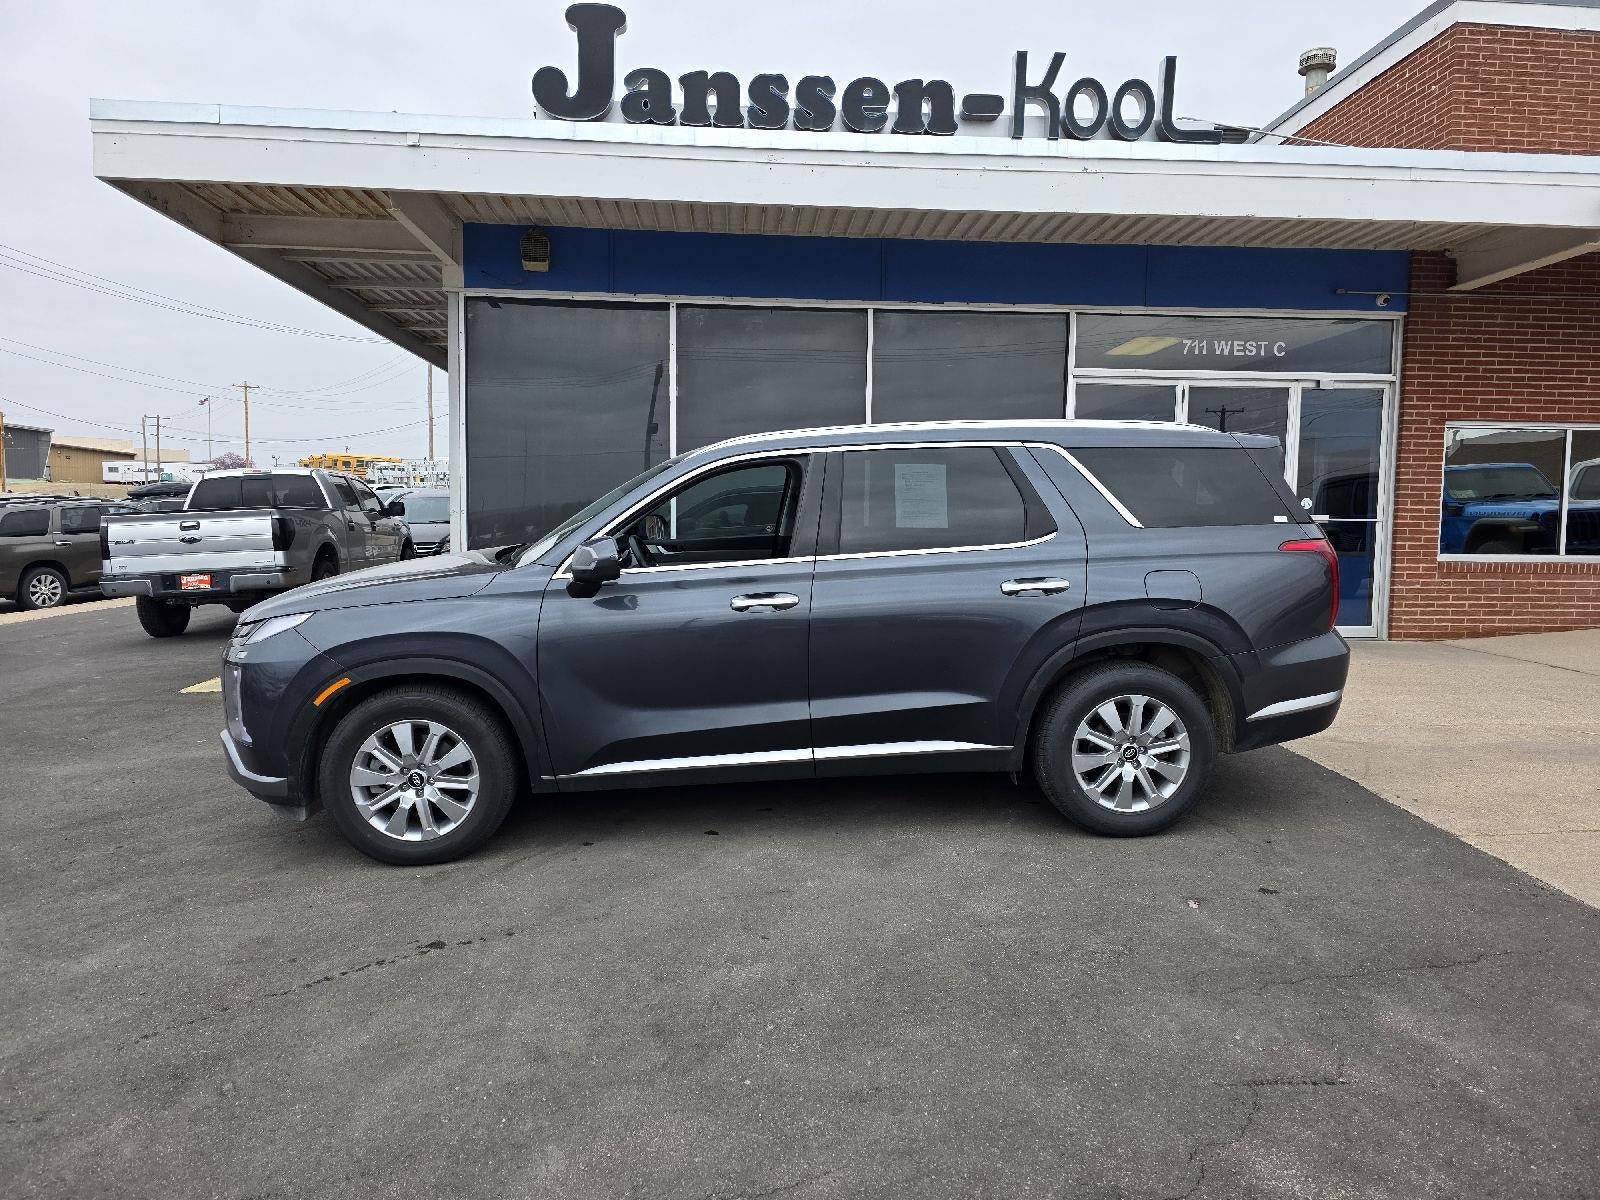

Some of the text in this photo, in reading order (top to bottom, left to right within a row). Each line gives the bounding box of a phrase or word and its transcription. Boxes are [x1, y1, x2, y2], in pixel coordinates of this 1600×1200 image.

[1182, 339, 1286, 357] 711 WEST C
